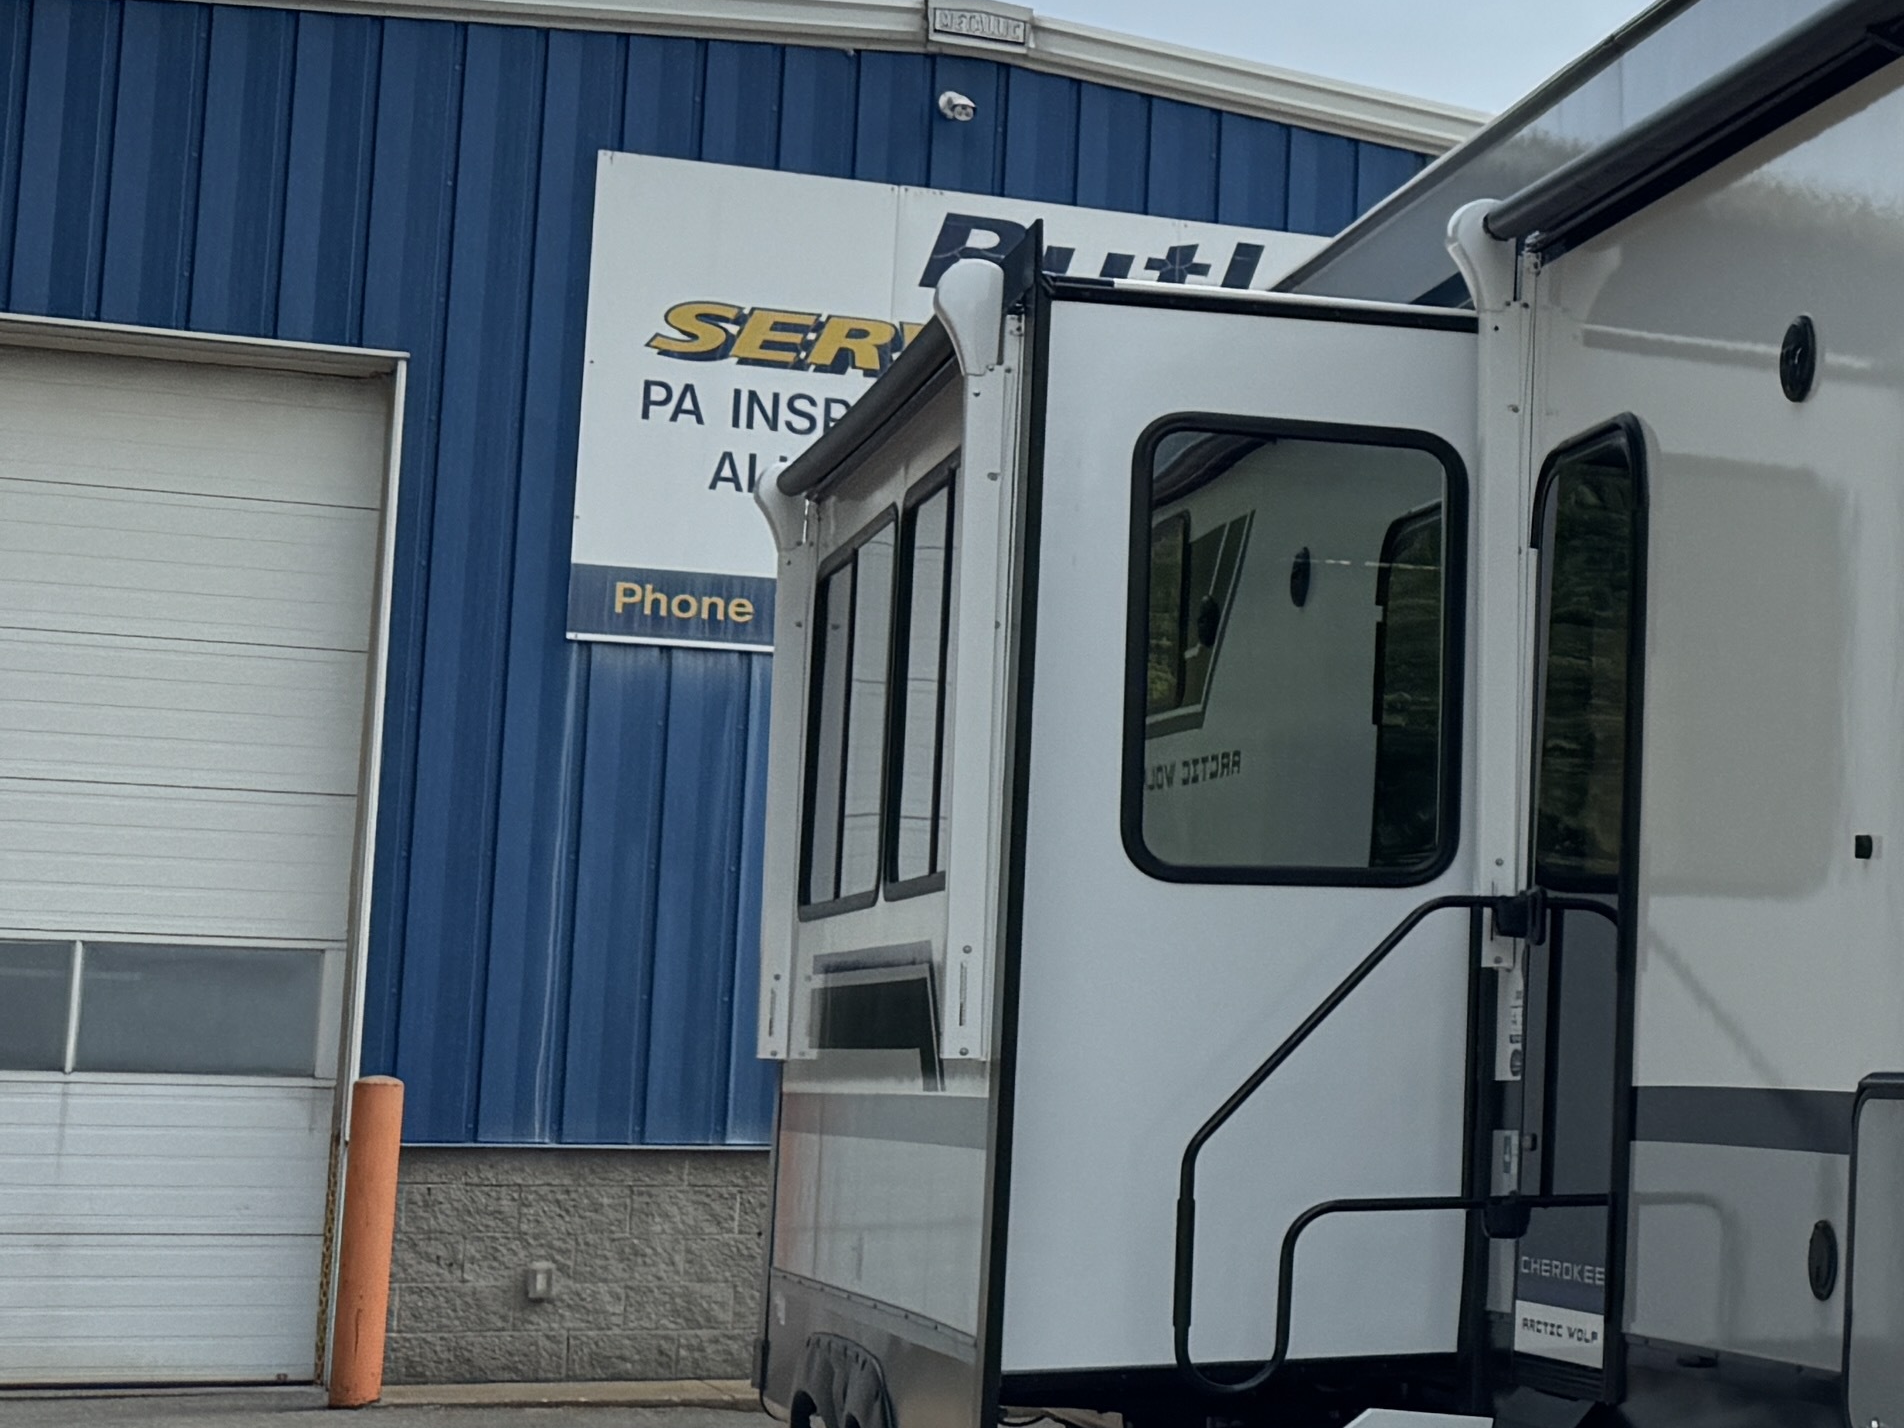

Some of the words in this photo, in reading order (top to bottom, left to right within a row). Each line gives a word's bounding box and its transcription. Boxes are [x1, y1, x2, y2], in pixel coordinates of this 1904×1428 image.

[641, 380, 704, 425] PA
[613, 581, 755, 623] Phone
[1520, 1255, 1606, 1286] CHEROKEE
[1521, 1316, 1564, 1339] ARCTIC
[1566, 1325, 1599, 1344] WOLF
